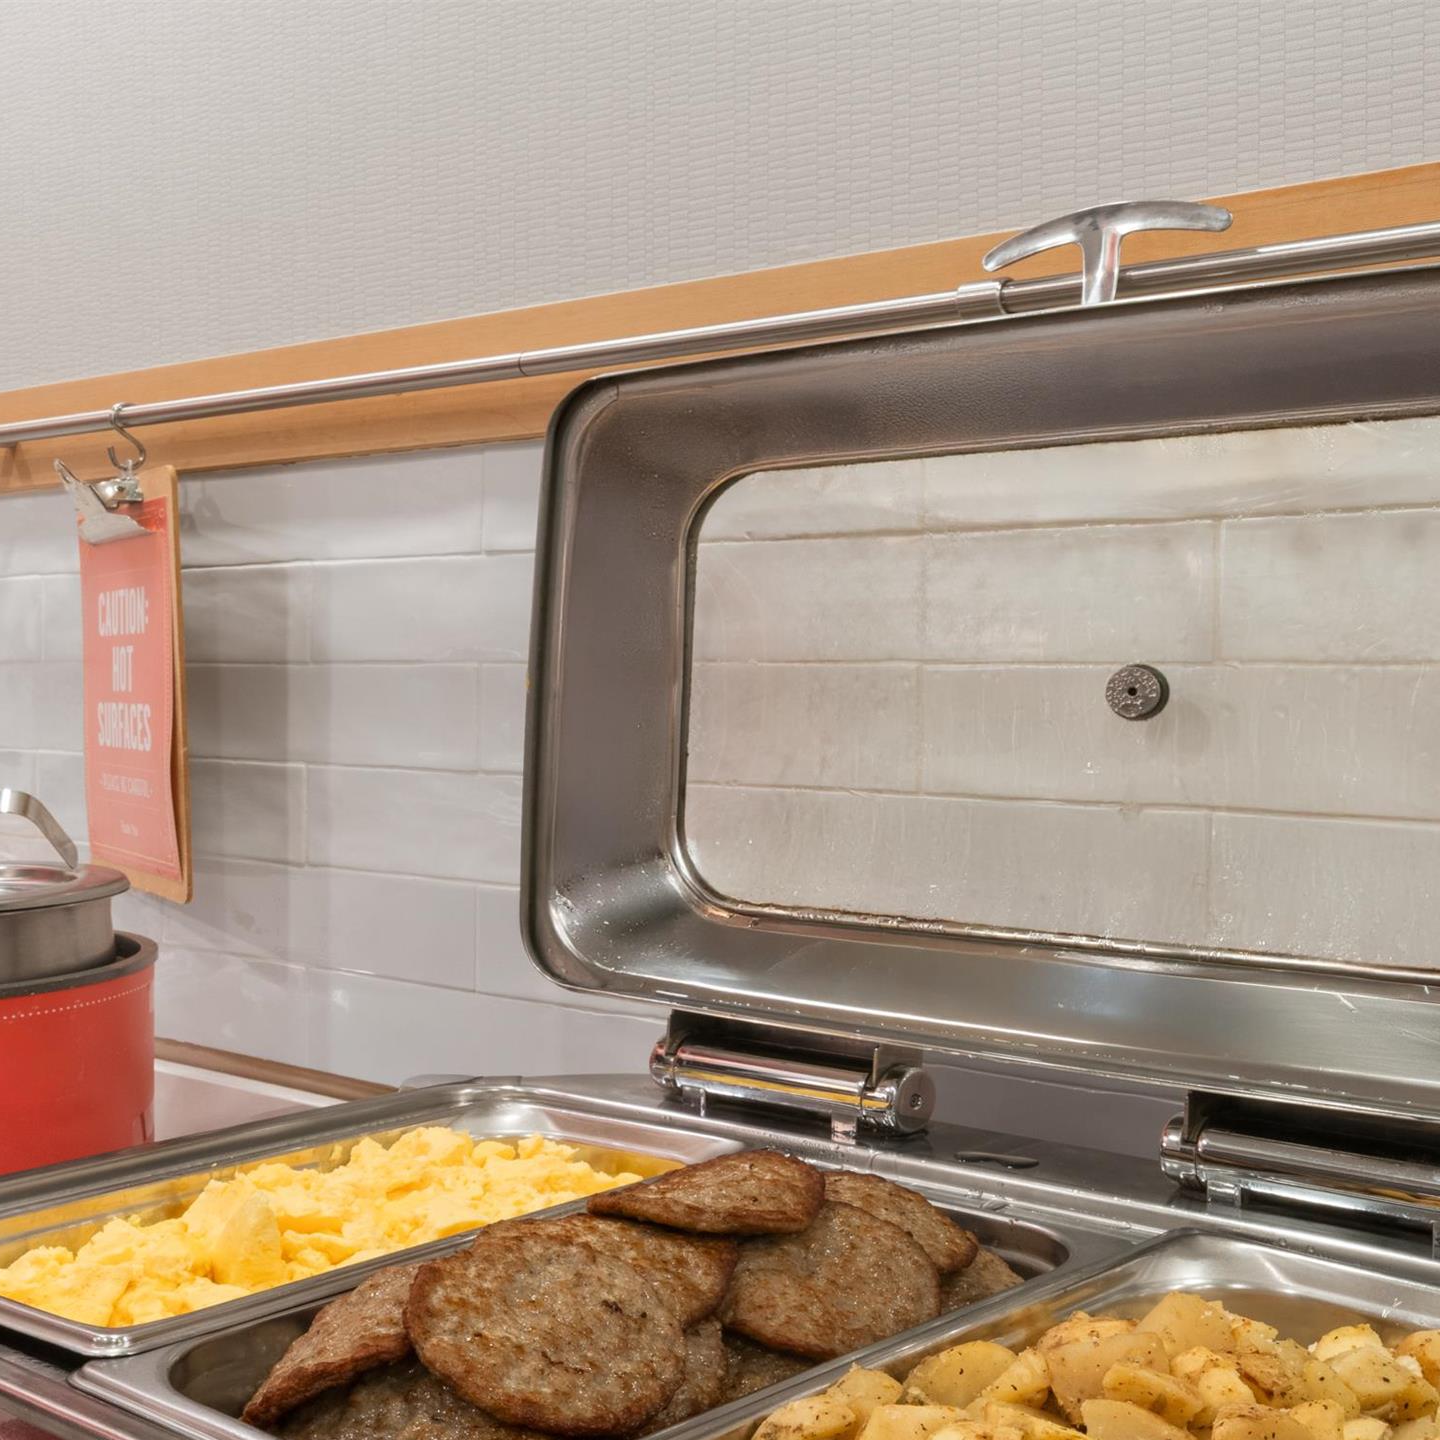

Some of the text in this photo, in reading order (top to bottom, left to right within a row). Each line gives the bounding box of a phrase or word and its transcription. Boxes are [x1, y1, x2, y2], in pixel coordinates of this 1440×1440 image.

[98, 586, 149, 637] CAUTION:
[112, 645, 134, 692] HOT
[97, 702, 152, 752] SURFACES
